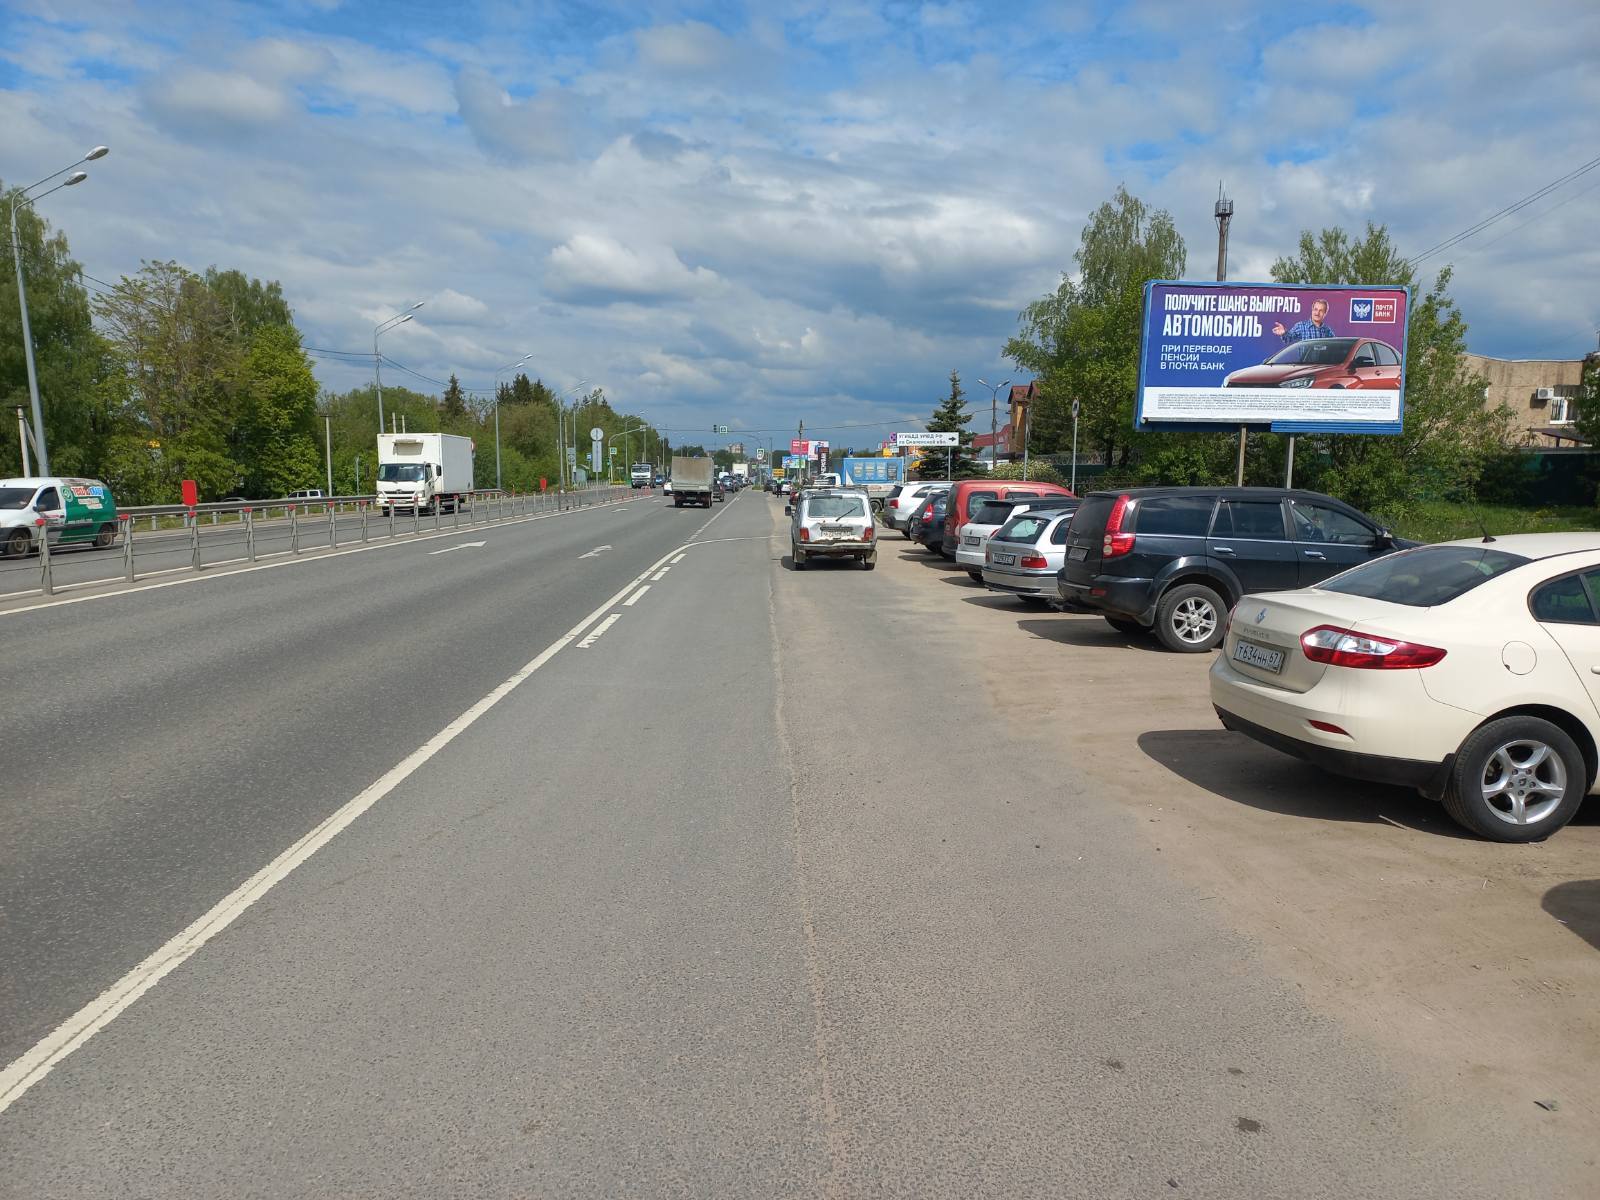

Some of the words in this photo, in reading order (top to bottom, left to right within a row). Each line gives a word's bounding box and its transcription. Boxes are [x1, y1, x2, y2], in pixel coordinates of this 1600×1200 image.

[1165, 294, 1216, 311] ПОЛУЧИТЕ
[1218, 295, 1247, 312] ШАНС
[1250, 296, 1301, 313] ВЫИГРАТЬ
[1163, 314, 1263, 337] АВТОМОБИЛЬ
[1161, 345, 1180, 353] ПРИ
[1182, 345, 1233, 354] ПЕРЕВОДЕ
[1160, 353, 1200, 362] ПЕНСИИ
[1160, 362, 1167, 370] В
[1168, 362, 1198, 370] ПОЧТА
[1200, 362, 1225, 370] БАНК
